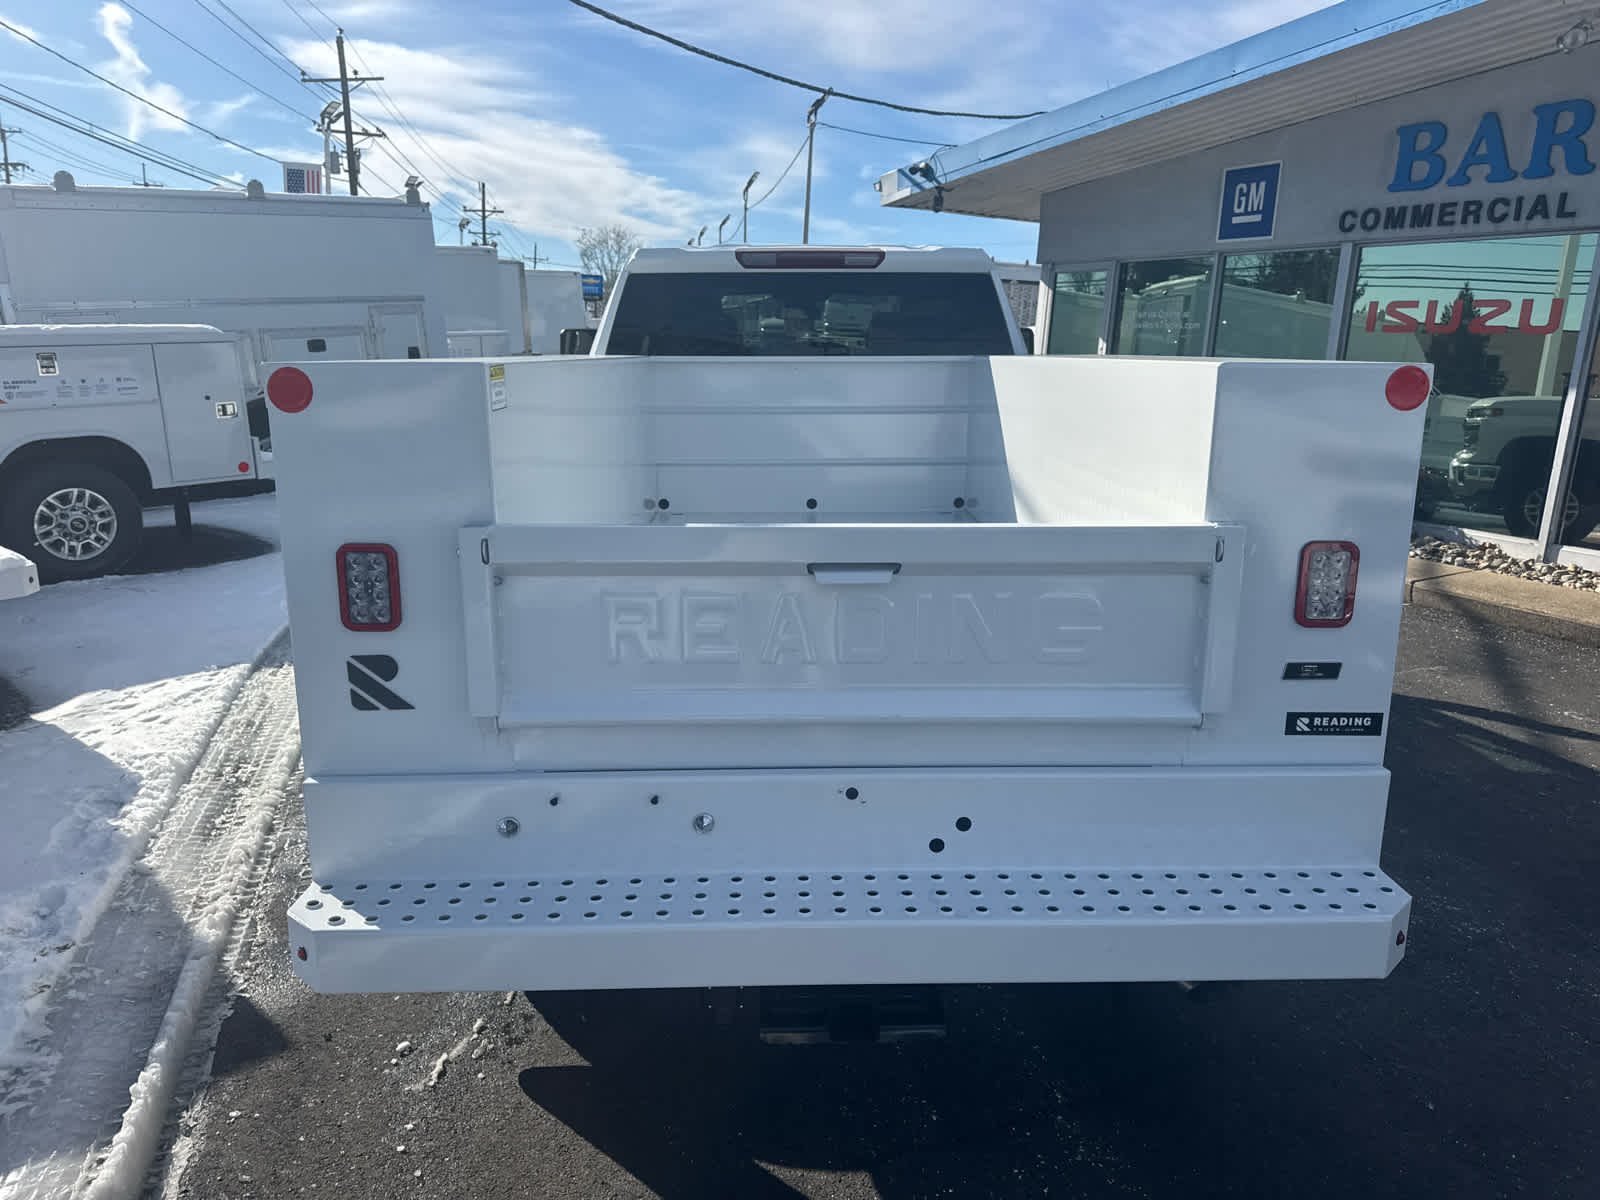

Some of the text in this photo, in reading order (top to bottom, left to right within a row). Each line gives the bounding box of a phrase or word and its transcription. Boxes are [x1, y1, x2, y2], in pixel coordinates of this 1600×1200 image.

[1387, 99, 1597, 192] BAR
[1232, 181, 1267, 215] GM
[1338, 191, 1577, 233] COMMERCIAL
[1365, 298, 1565, 335] ISUZU
[603, 591, 1104, 665] READING
[1313, 717, 1372, 726] READING
